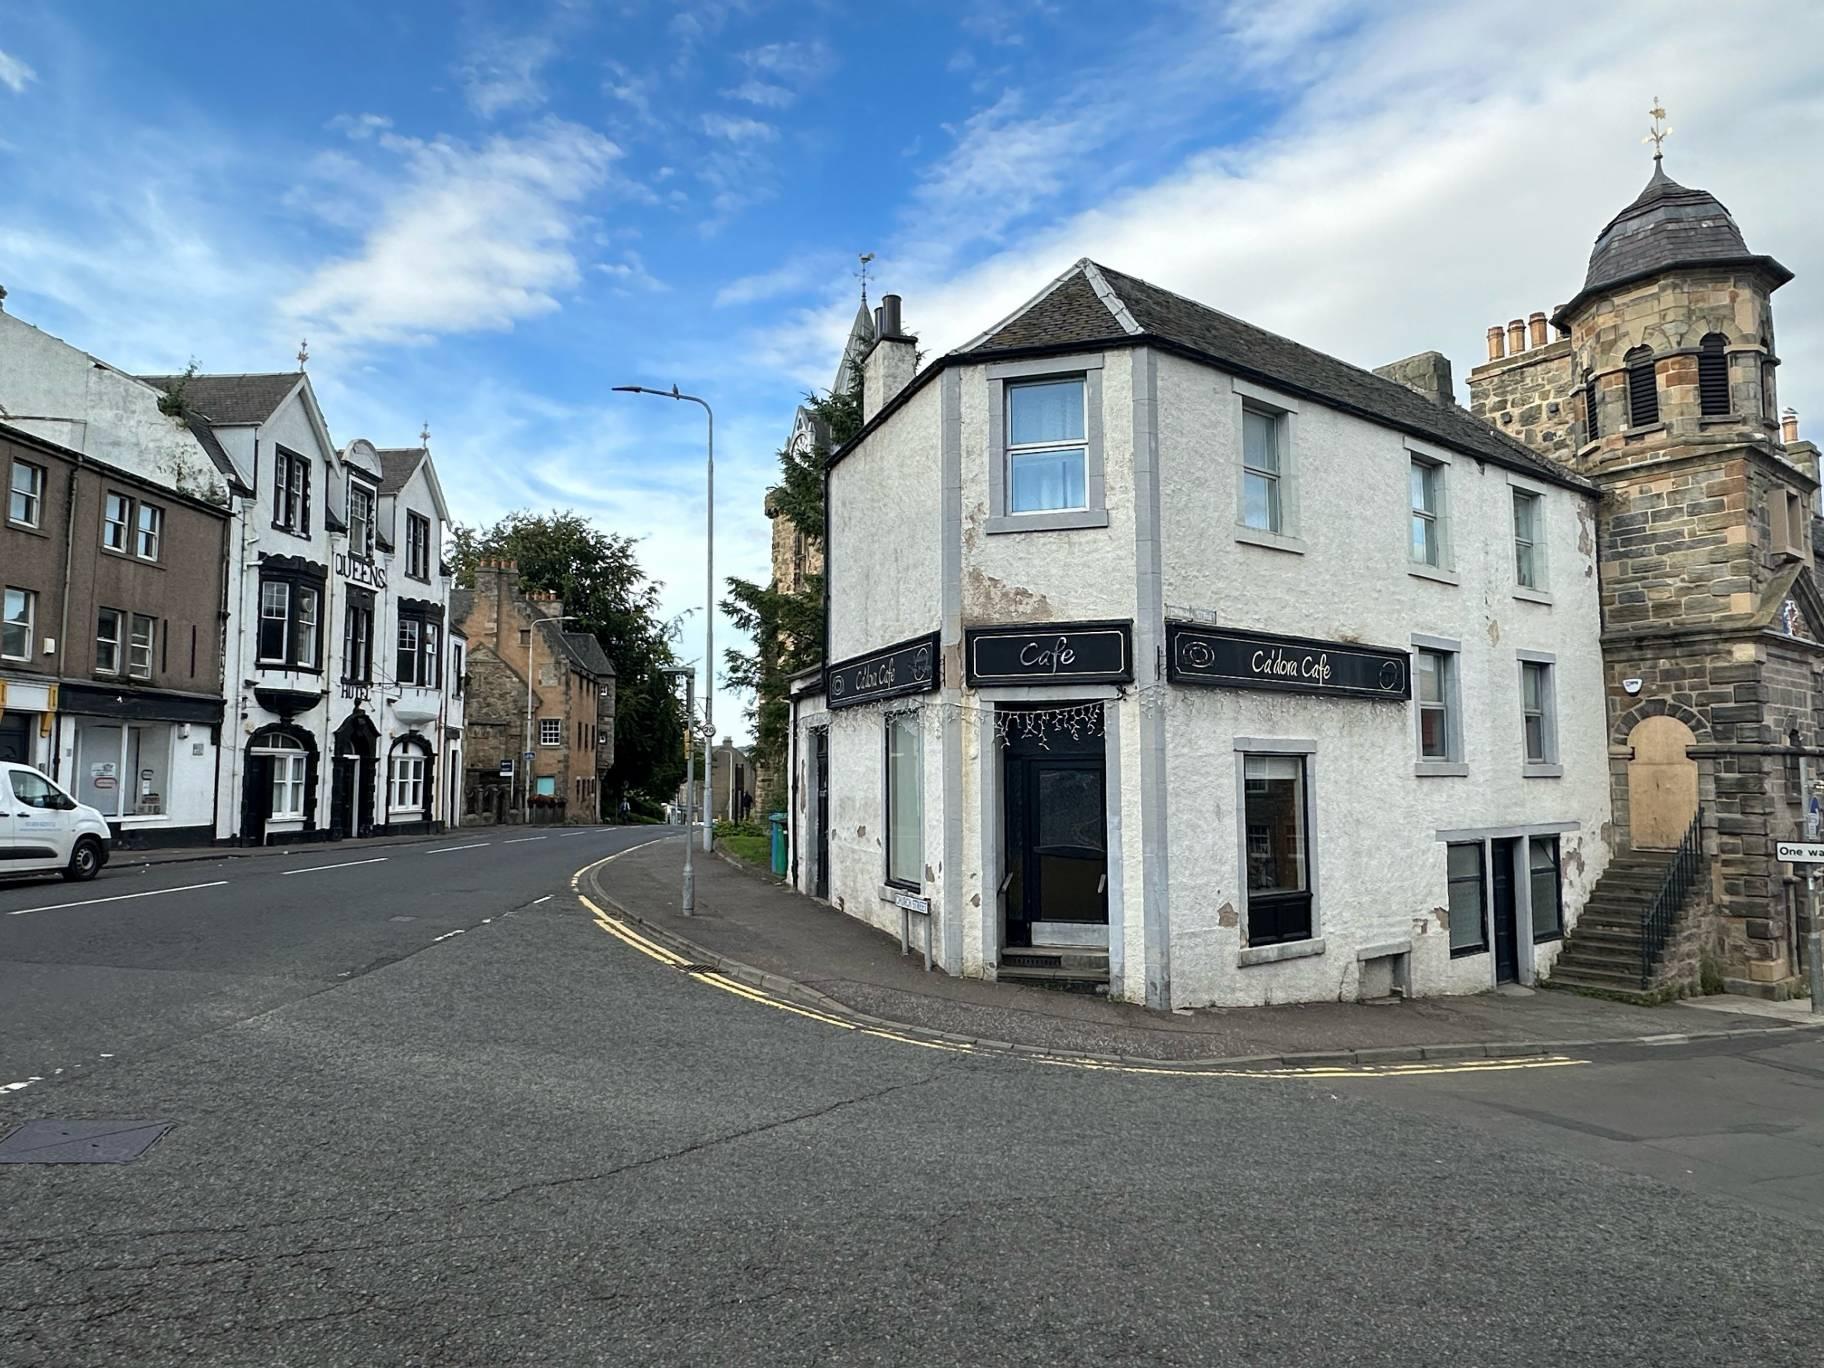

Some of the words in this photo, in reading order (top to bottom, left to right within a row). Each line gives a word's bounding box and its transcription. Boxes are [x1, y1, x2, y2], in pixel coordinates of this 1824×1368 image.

[336, 553, 386, 589] QUEENS
[879, 657, 896, 689] Cafe
[1020, 636, 1076, 674] Cafe
[1252, 648, 1298, 677] Ca'dora
[1302, 653, 1332, 686] Cafe
[1779, 846, 1804, 857] One
